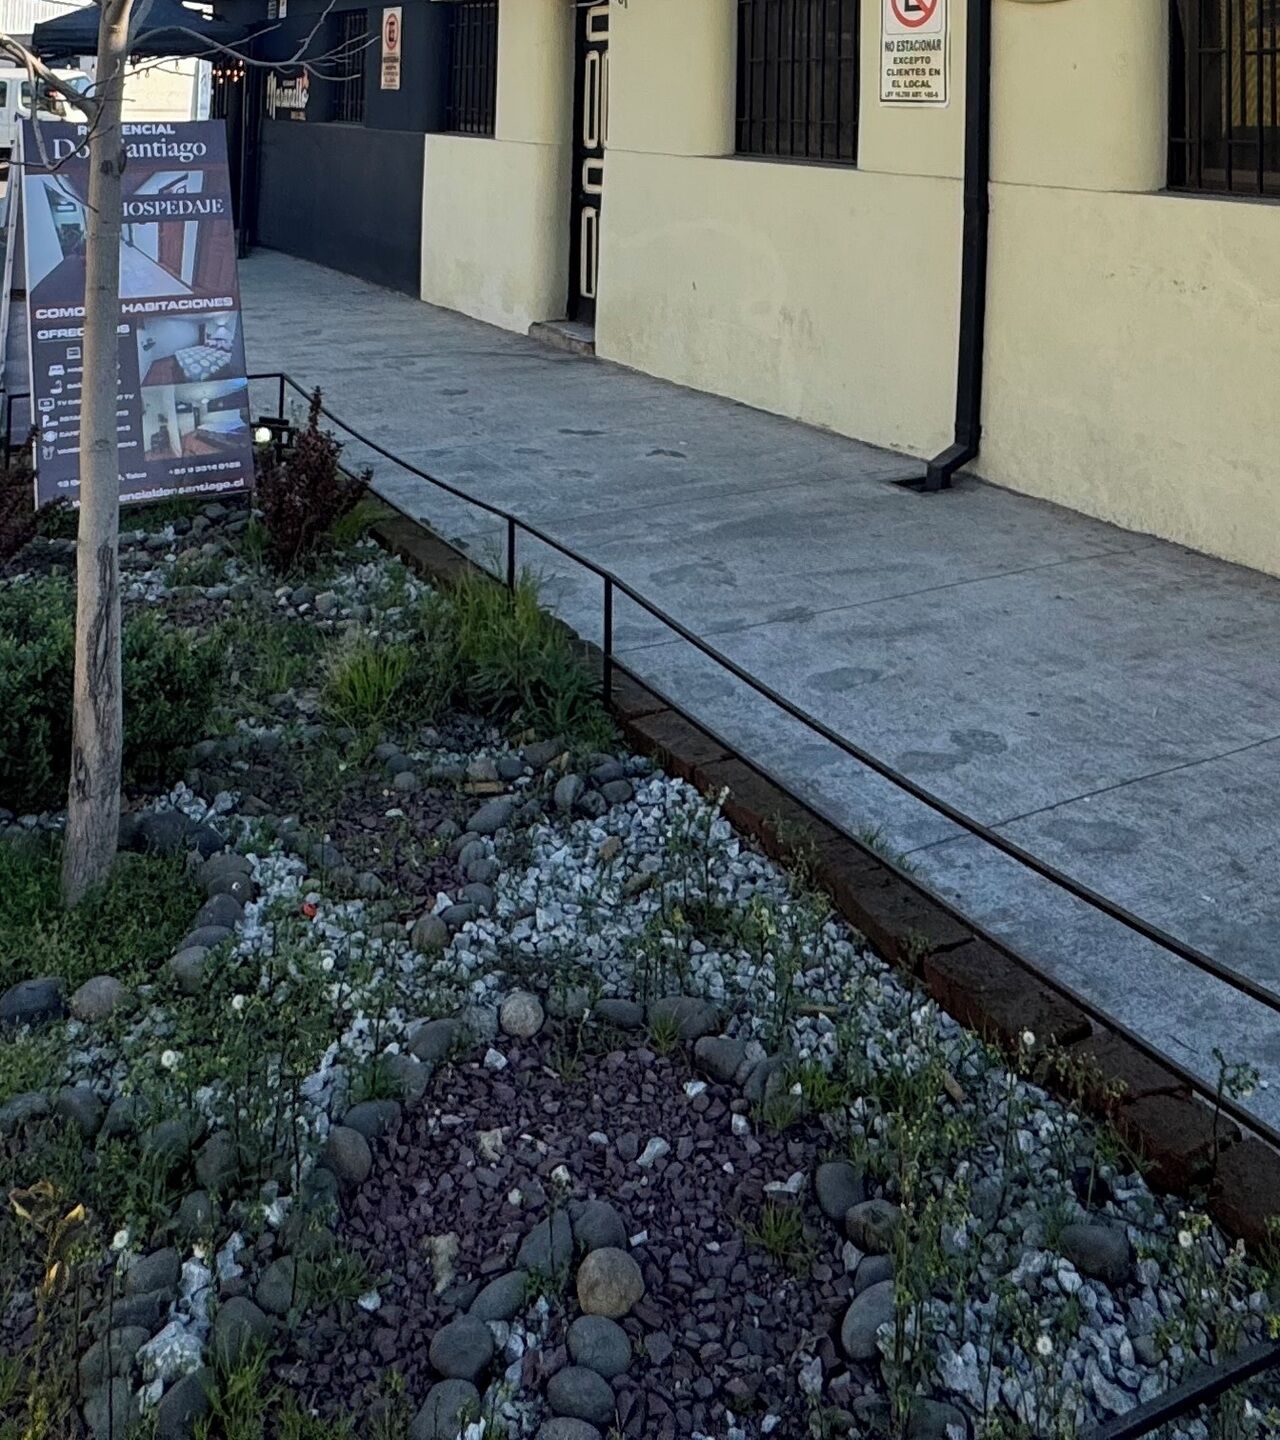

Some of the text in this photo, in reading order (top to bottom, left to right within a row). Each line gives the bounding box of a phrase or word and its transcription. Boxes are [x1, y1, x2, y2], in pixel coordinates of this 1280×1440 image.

[884, 38, 942, 52] NO ESTACIONAR
[893, 56, 931, 65] EXCEPTO
[886, 68, 941, 76] CLIENTES EN
[891, 79, 932, 88] EL LOCAL
[77, 124, 176, 136] RENCIAL
[120, 138, 207, 163] antiago
[121, 296, 234, 314] HABITACIONES
